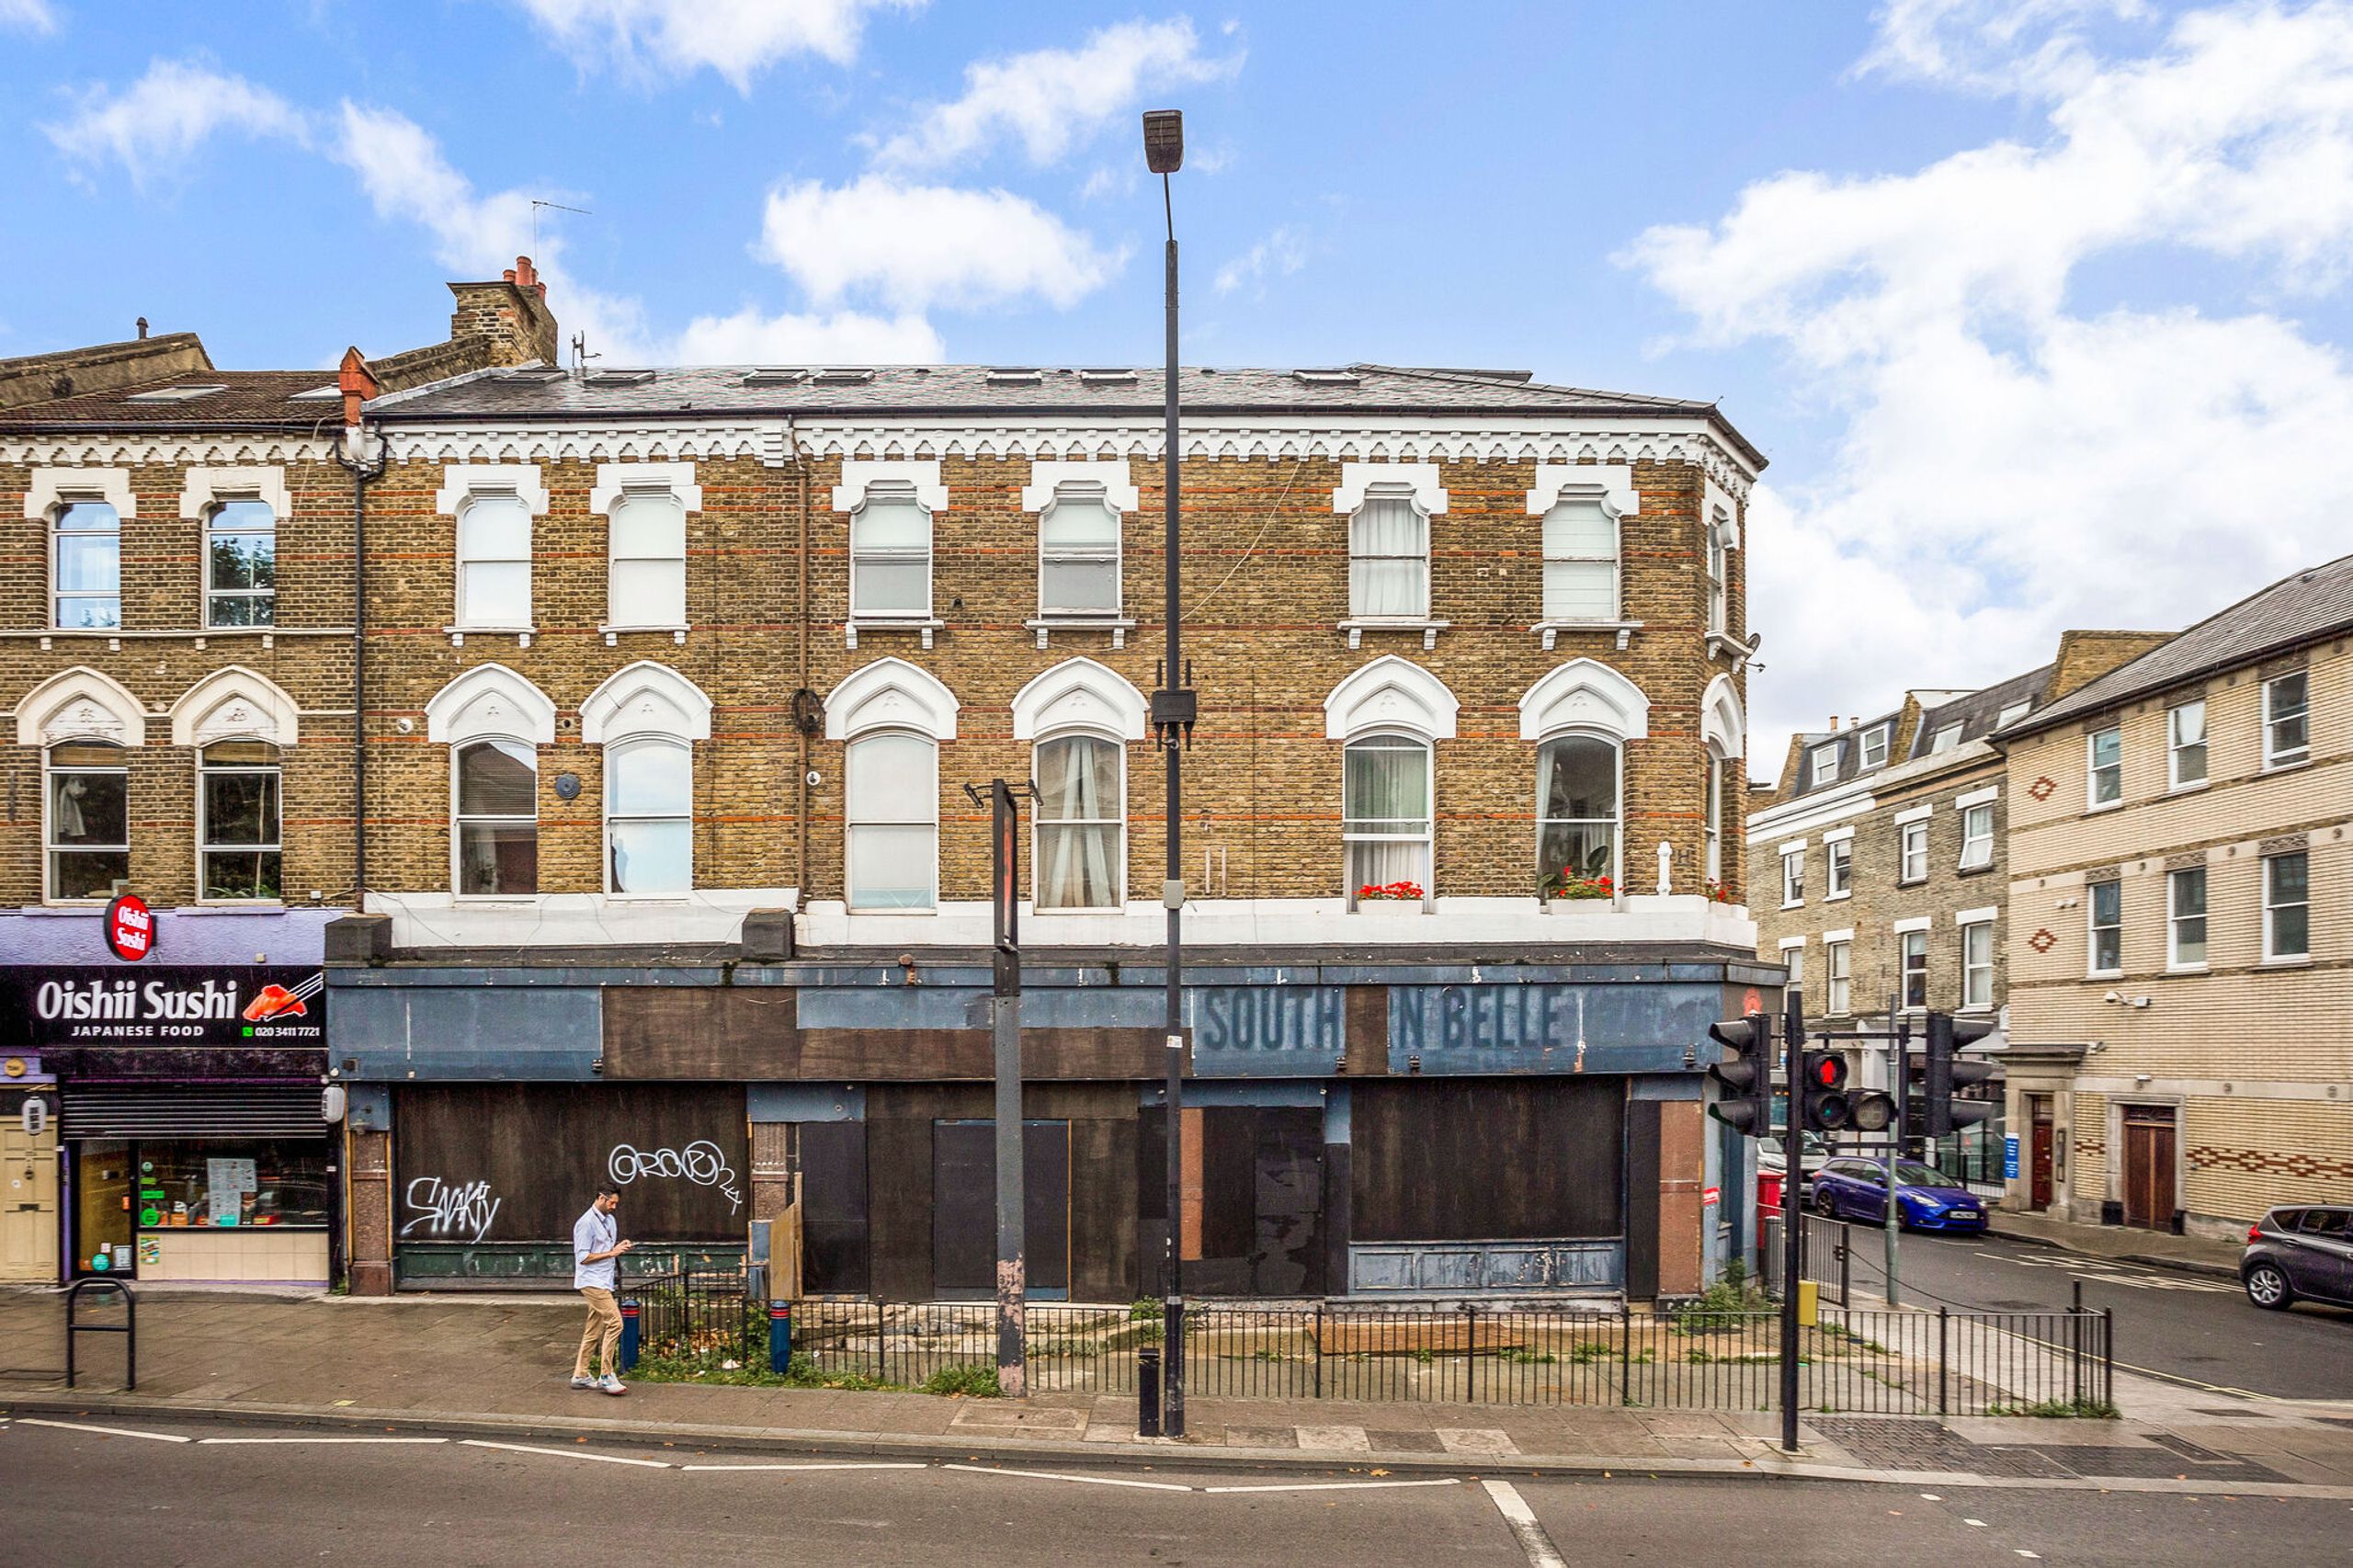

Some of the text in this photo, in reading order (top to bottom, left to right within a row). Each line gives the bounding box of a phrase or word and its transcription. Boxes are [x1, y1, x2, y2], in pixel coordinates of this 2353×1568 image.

[118, 905, 150, 930] Oishii
[116, 926, 147, 951] Sushi
[37, 980, 238, 1020] Oishii Sushi
[1443, 985, 1562, 1049] BELLE
[71, 1026, 205, 1038] JAPANESE FOOD
[255, 1027, 320, 1038] 020 3411 7721
